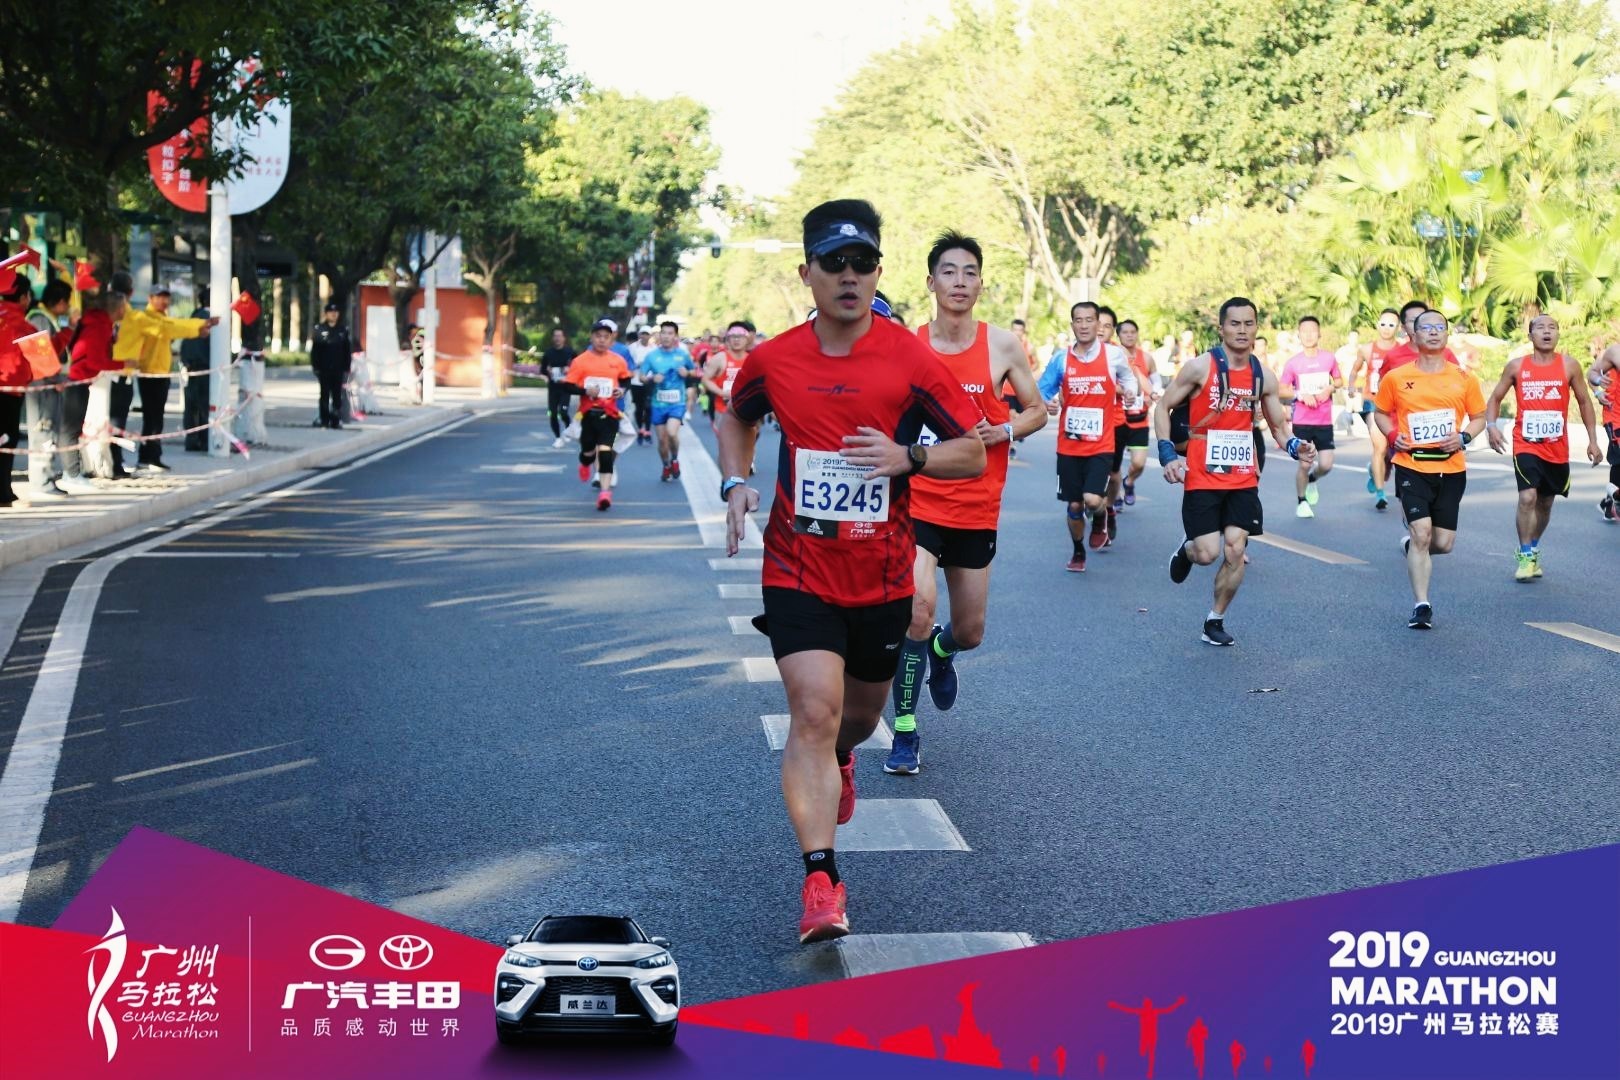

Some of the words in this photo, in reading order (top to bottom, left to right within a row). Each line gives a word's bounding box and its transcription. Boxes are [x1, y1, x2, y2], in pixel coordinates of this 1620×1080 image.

[1068, 386, 1090, 395] 2019
[1523, 390, 1544, 400] 2019
[1067, 418, 1100, 431] E2241
[1413, 422, 1454, 441] E2207
[1526, 422, 1561, 434] E1036
[1211, 445, 1251, 461] E0996
[801, 479, 883, 513] E3245
[900, 652, 921, 710] kalenji
